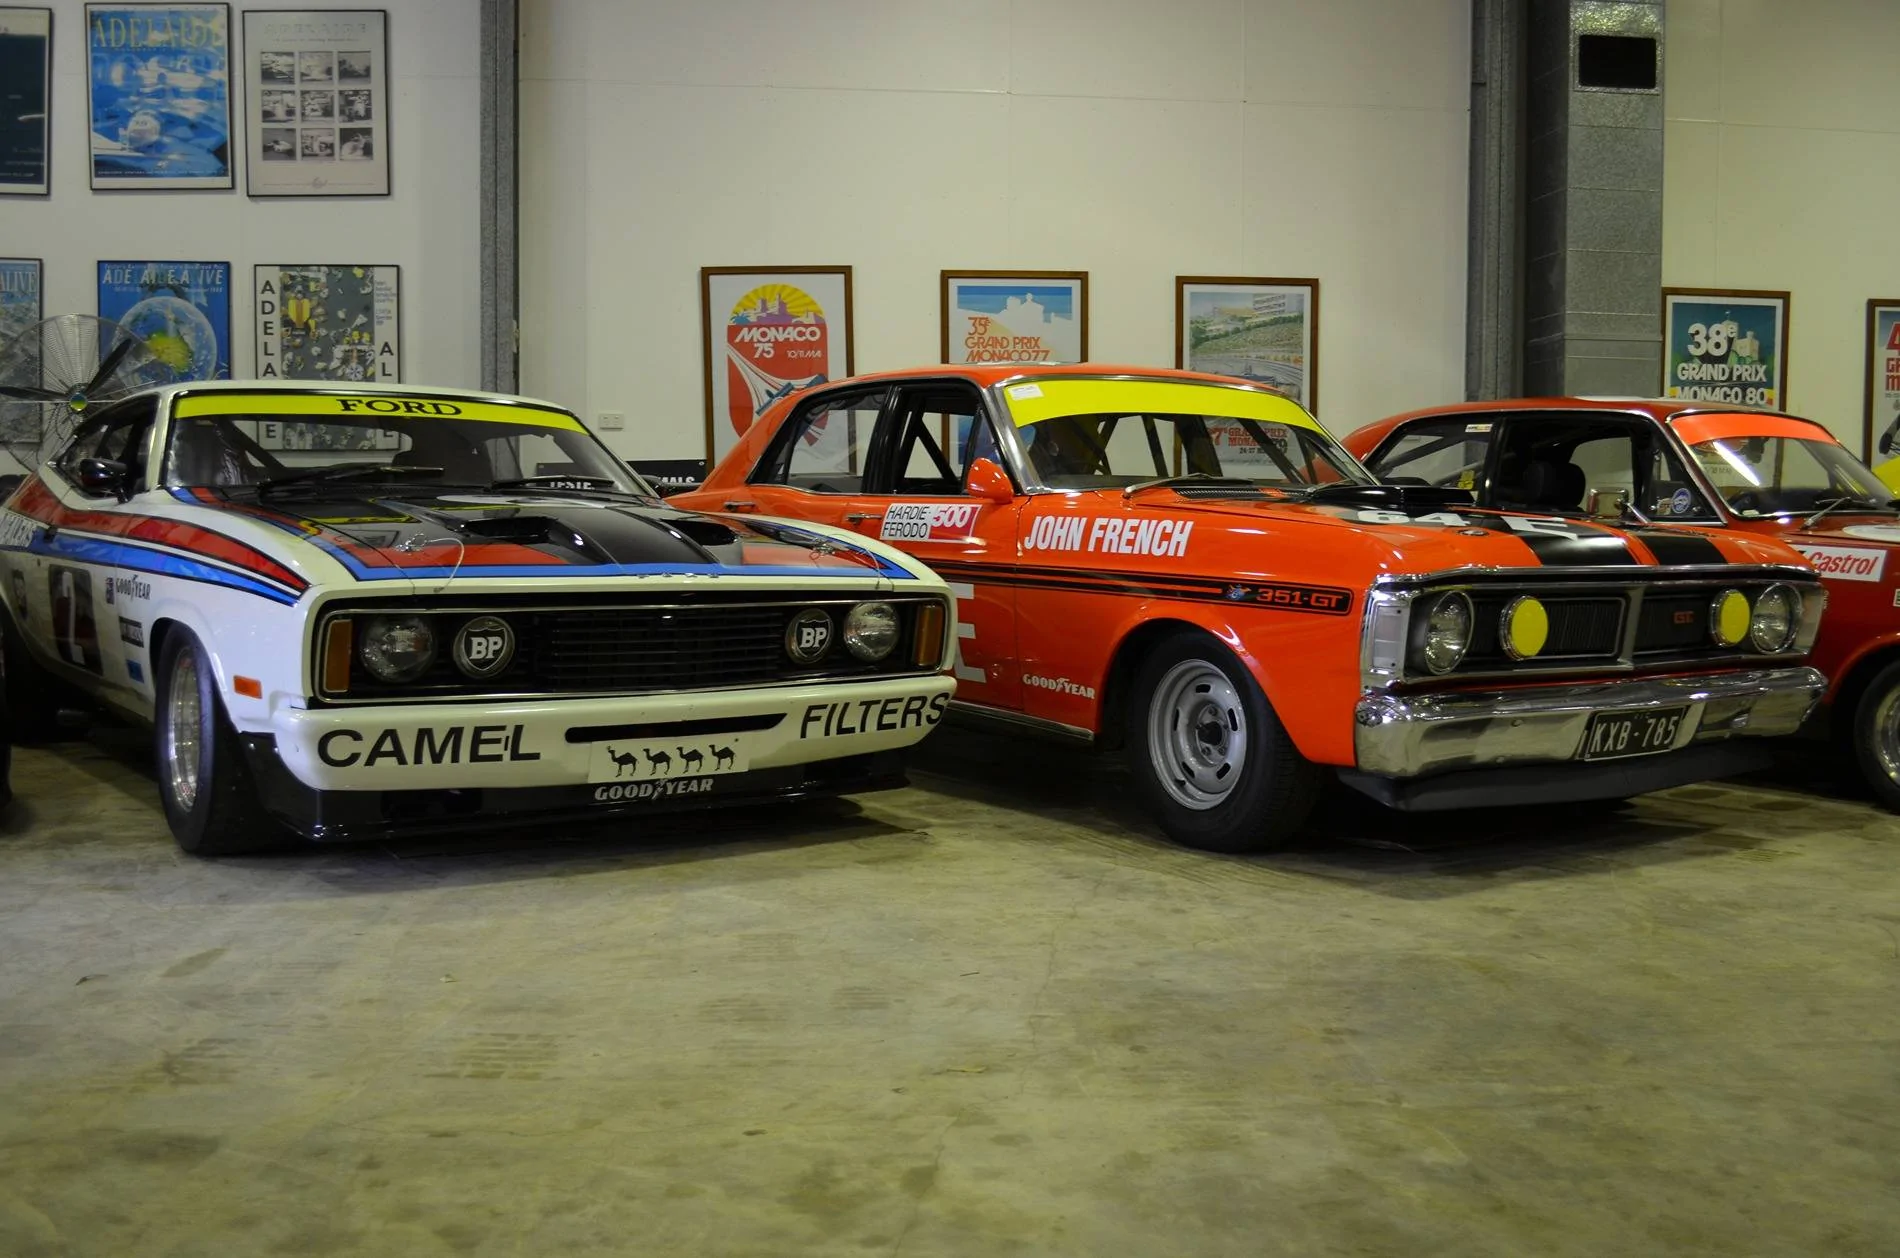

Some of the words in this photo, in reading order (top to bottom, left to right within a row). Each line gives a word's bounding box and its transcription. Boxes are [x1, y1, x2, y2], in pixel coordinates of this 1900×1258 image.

[734, 326, 821, 343] MONACO
[965, 336, 1010, 349] GRAND
[1012, 336, 1041, 349] PRIX
[754, 343, 775, 358] 75
[1676, 363, 1729, 381] GRAND
[1732, 364, 1767, 382] PRIX
[1676, 386, 1742, 404] MONACO
[1745, 387, 1767, 405] 80
[336, 399, 462, 416] FORD
[931, 504, 972, 528] 500
[882, 522, 928, 538] FERODO
[1024, 515, 1088, 551] JOHN
[1087, 517, 1194, 557] FRENCH
[1808, 551, 1880, 575] Castrol
[469, 636, 503, 660] BP
[800, 627, 827, 648] BP
[1022, 674, 1095, 699] GOODYEAR
[801, 692, 950, 739] FILTERS
[317, 725, 541, 768] CAMEL
[594, 778, 714, 801] GOODYEAR
